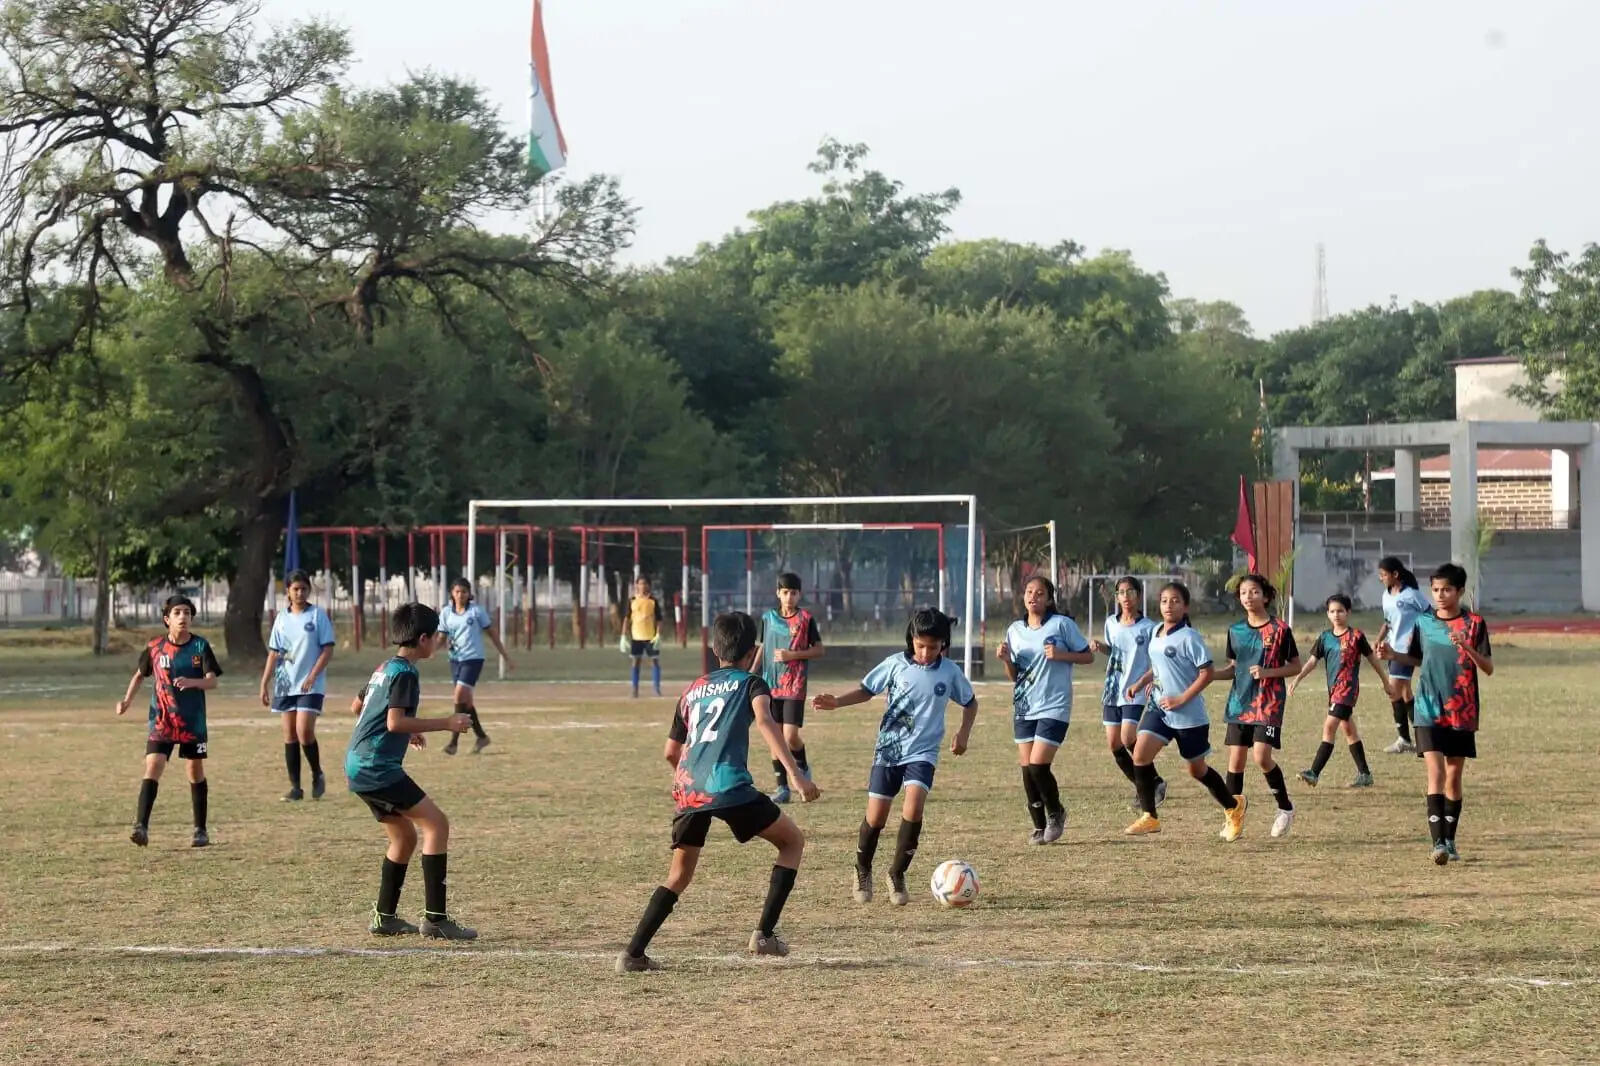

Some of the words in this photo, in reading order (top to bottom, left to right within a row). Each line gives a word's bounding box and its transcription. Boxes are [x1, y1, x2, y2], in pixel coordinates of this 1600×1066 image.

[160, 655, 170, 668] 01
[689, 697, 725, 748] 12
[1265, 726, 1275, 738] 31
